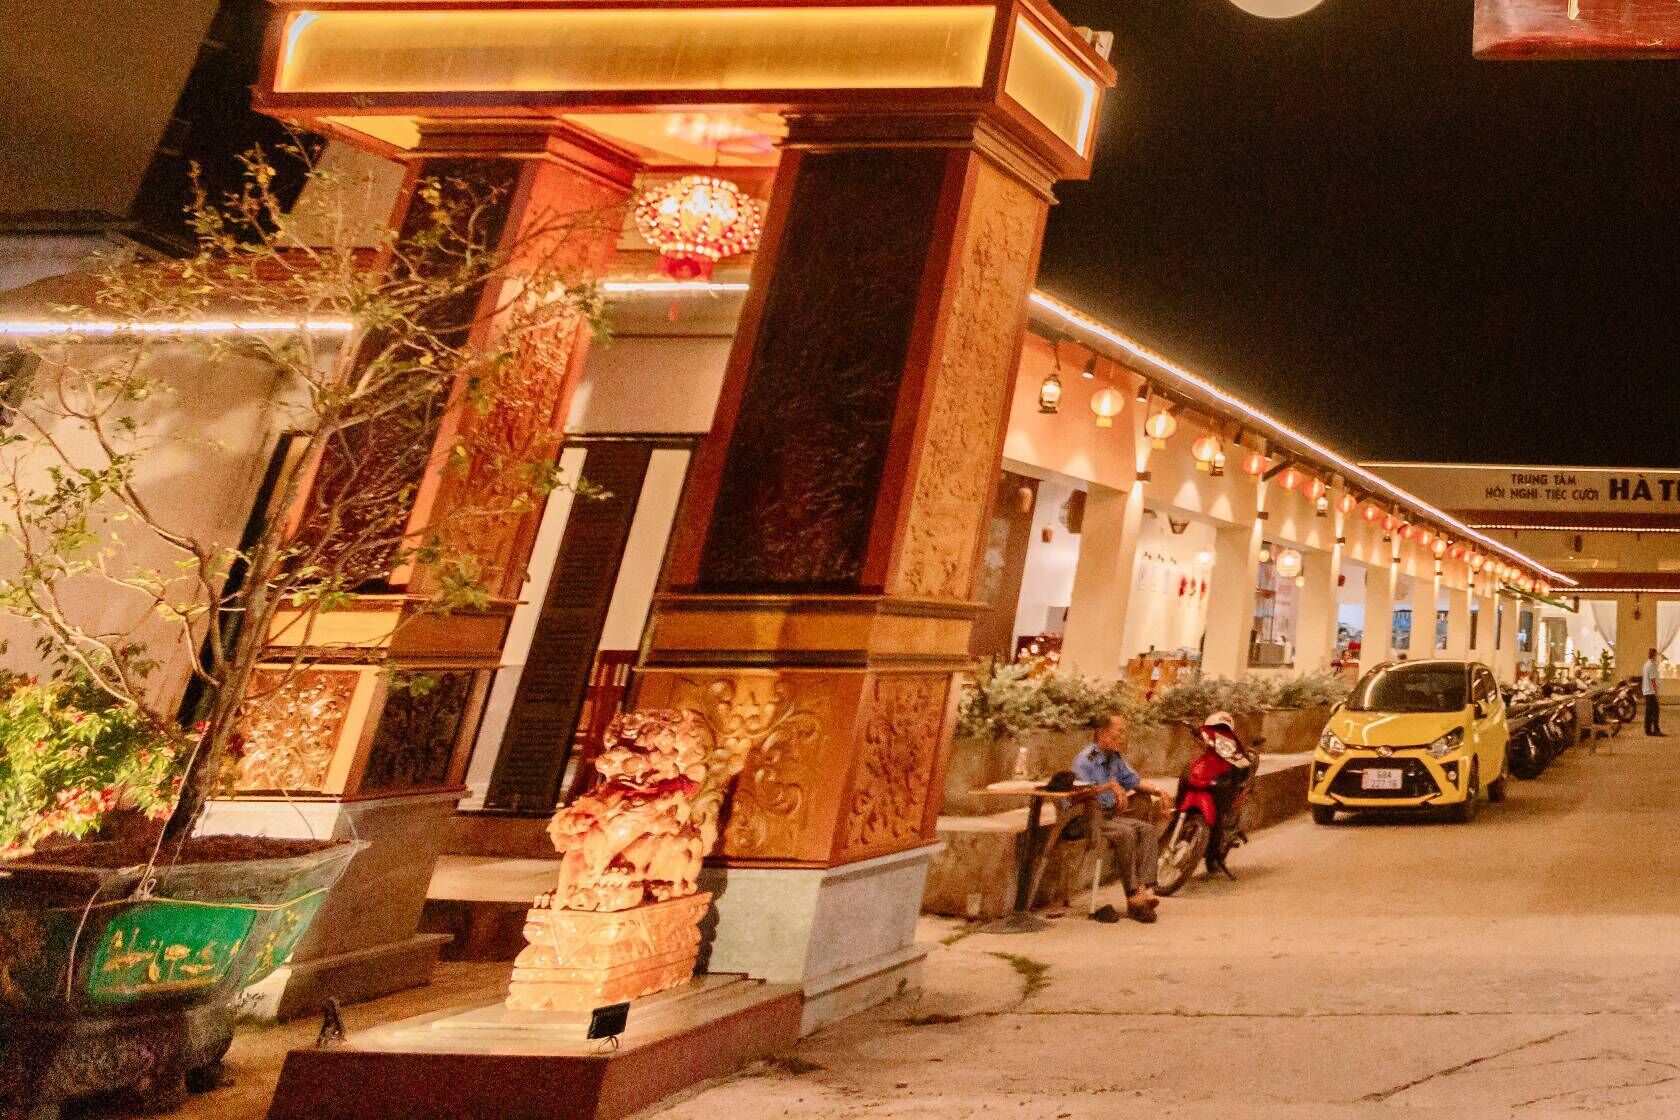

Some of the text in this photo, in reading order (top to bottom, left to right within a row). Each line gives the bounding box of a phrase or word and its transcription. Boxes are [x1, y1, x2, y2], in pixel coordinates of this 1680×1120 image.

[1511, 472, 1577, 485] TRUNG TÂM
[1609, 474, 1653, 501] HÀ
